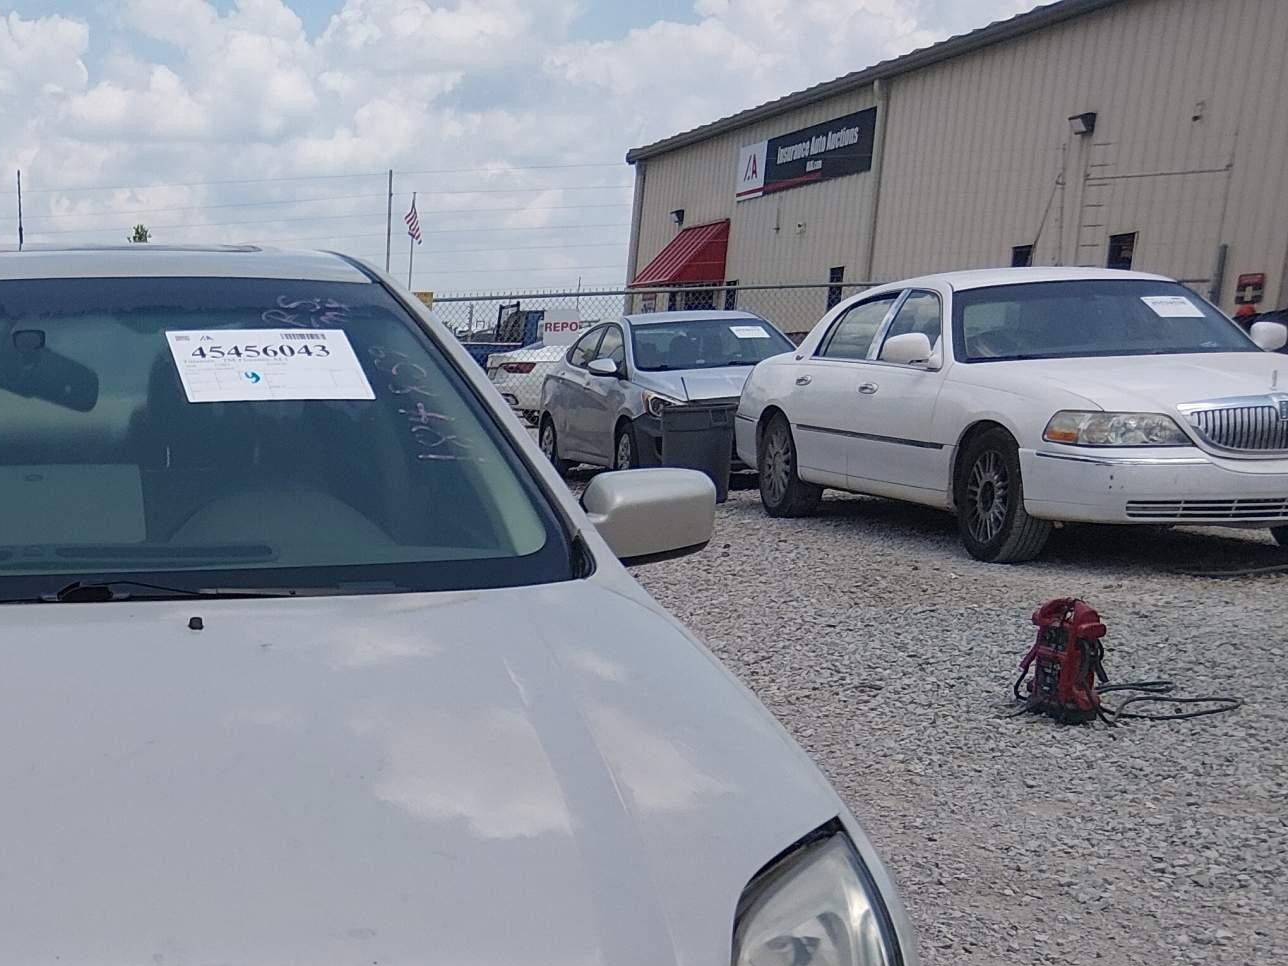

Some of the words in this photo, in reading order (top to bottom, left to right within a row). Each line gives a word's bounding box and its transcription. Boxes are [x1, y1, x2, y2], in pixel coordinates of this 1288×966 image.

[777, 140, 810, 165] Insurance
[810, 135, 827, 156] Auto
[826, 127, 859, 151] Auctions
[544, 321, 579, 332] REPO
[191, 344, 330, 359] 45456043
